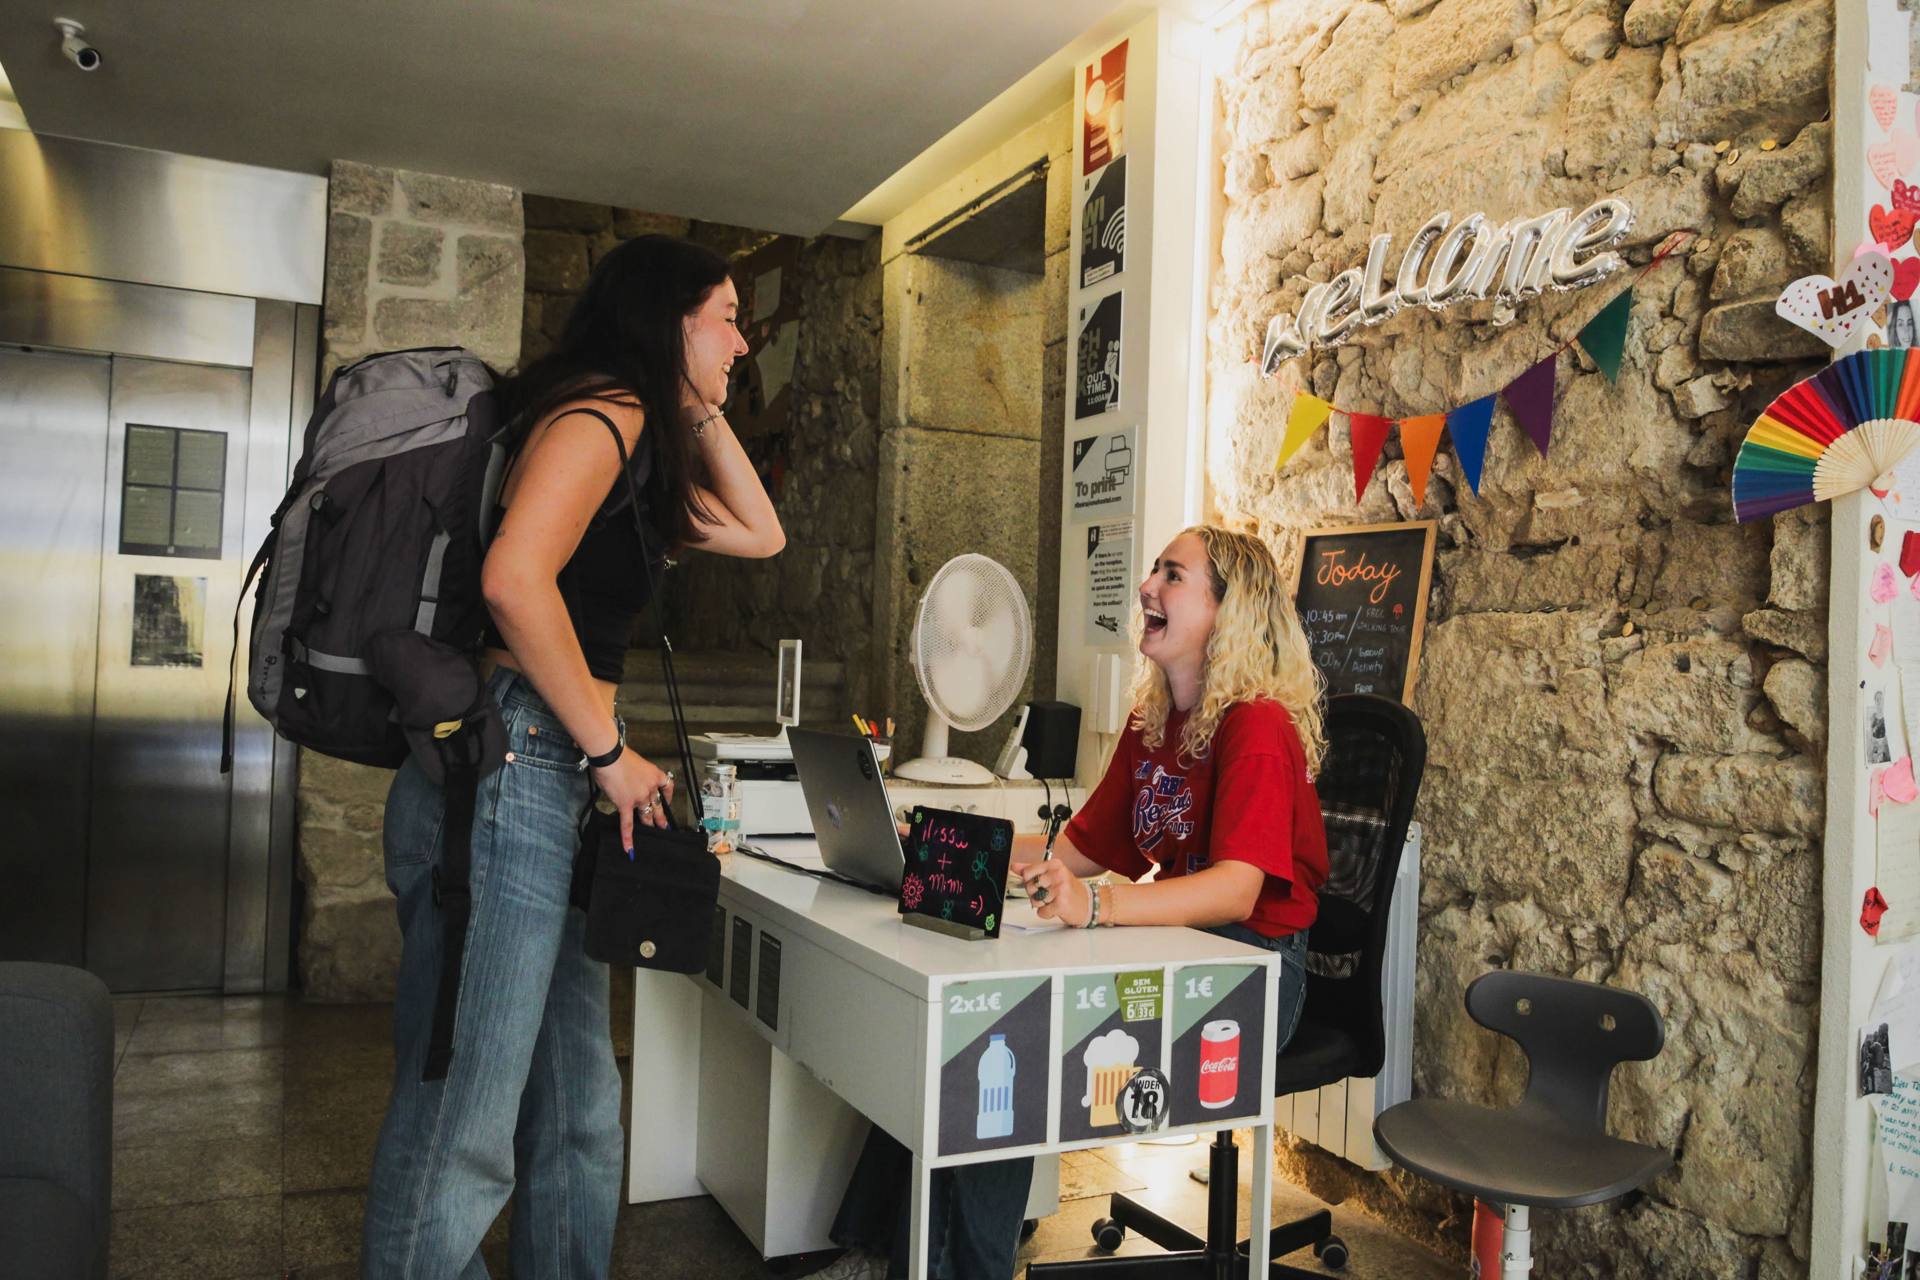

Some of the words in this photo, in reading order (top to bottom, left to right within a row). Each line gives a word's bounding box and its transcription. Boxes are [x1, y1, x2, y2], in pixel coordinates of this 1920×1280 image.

[1082, 195, 1105, 229] WI
[1082, 223, 1098, 254] FI
[1087, 370, 1105, 385] OUT
[1087, 380, 1107, 395] TIME
[1075, 481, 1088, 497] To
[1091, 475, 1117, 498] print
[1316, 548, 1401, 605] Today
[1305, 609, 1335, 625] 10:45
[1132, 978, 1151, 986] SEM
[1185, 976, 1213, 999] 1€
[949, 991, 1002, 1015] 2x1€
[1076, 986, 1107, 1009] 1€
[1130, 1089, 1158, 1119] 18
